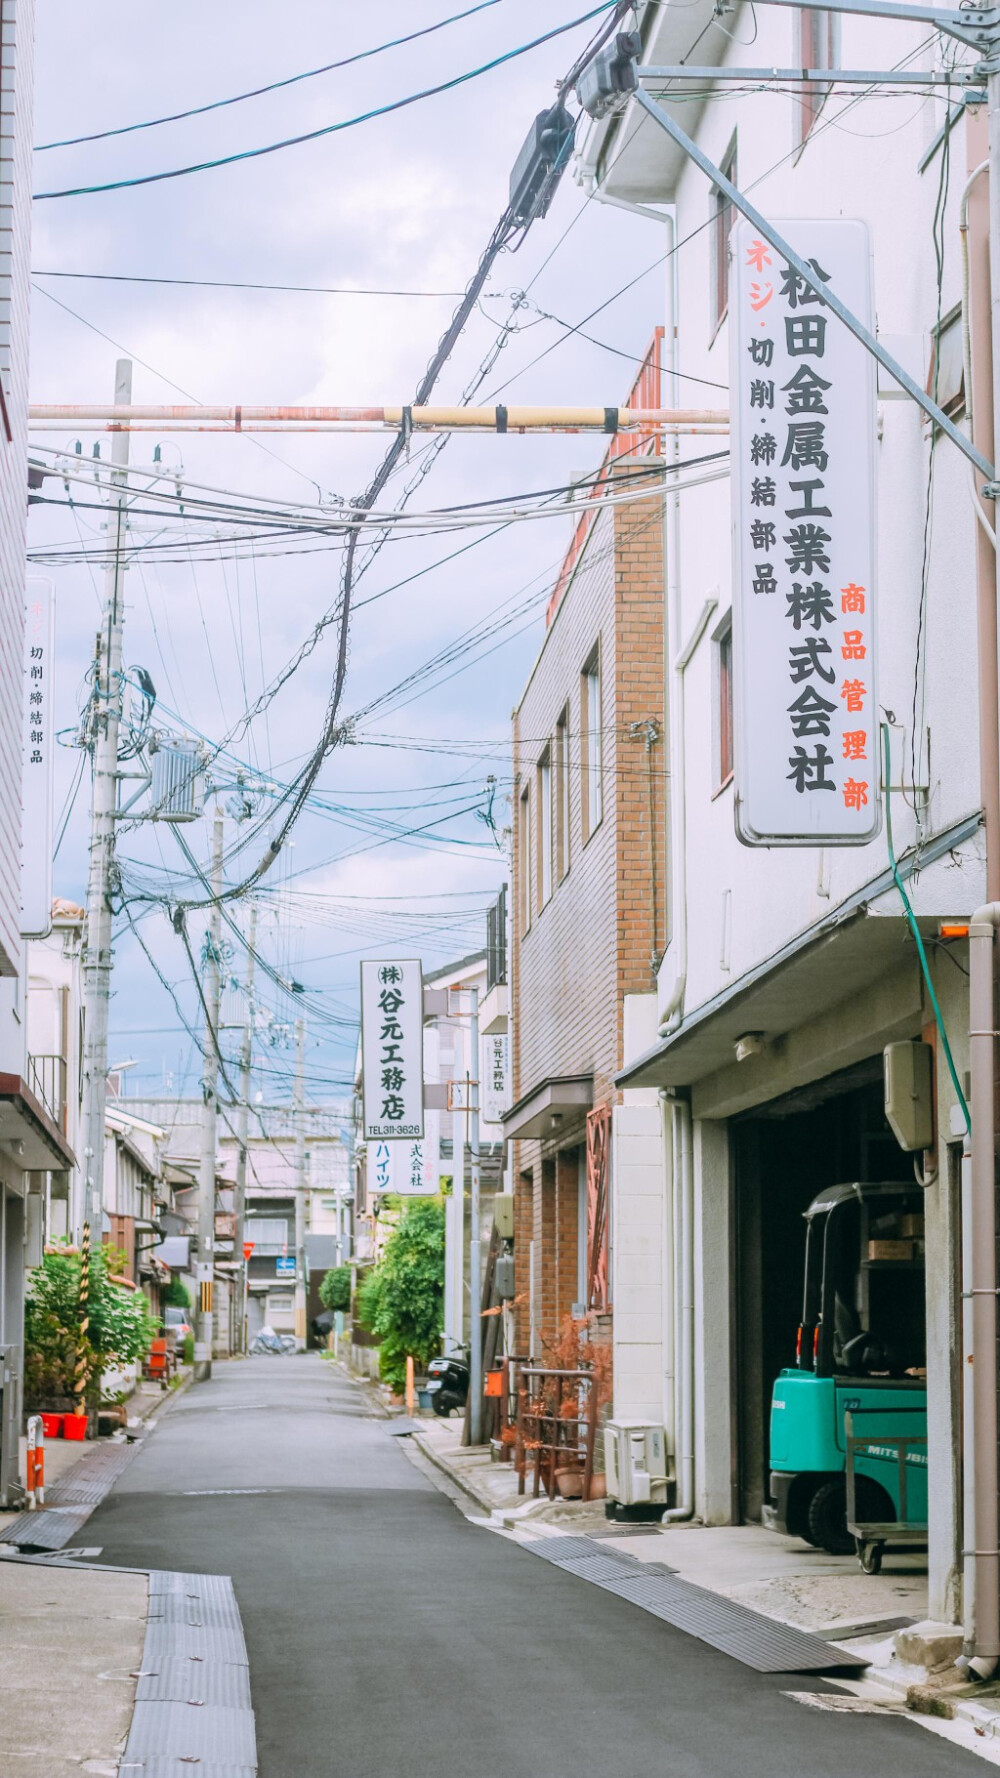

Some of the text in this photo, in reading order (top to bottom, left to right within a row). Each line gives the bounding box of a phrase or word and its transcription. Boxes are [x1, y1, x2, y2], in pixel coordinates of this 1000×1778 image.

[779, 258, 839, 794] 松田金属工業株式会社
[840, 583, 869, 812] 商品管理部
[376, 1140, 390, 1188] ハイツ
[409, 1139, 424, 1187] 式会社
